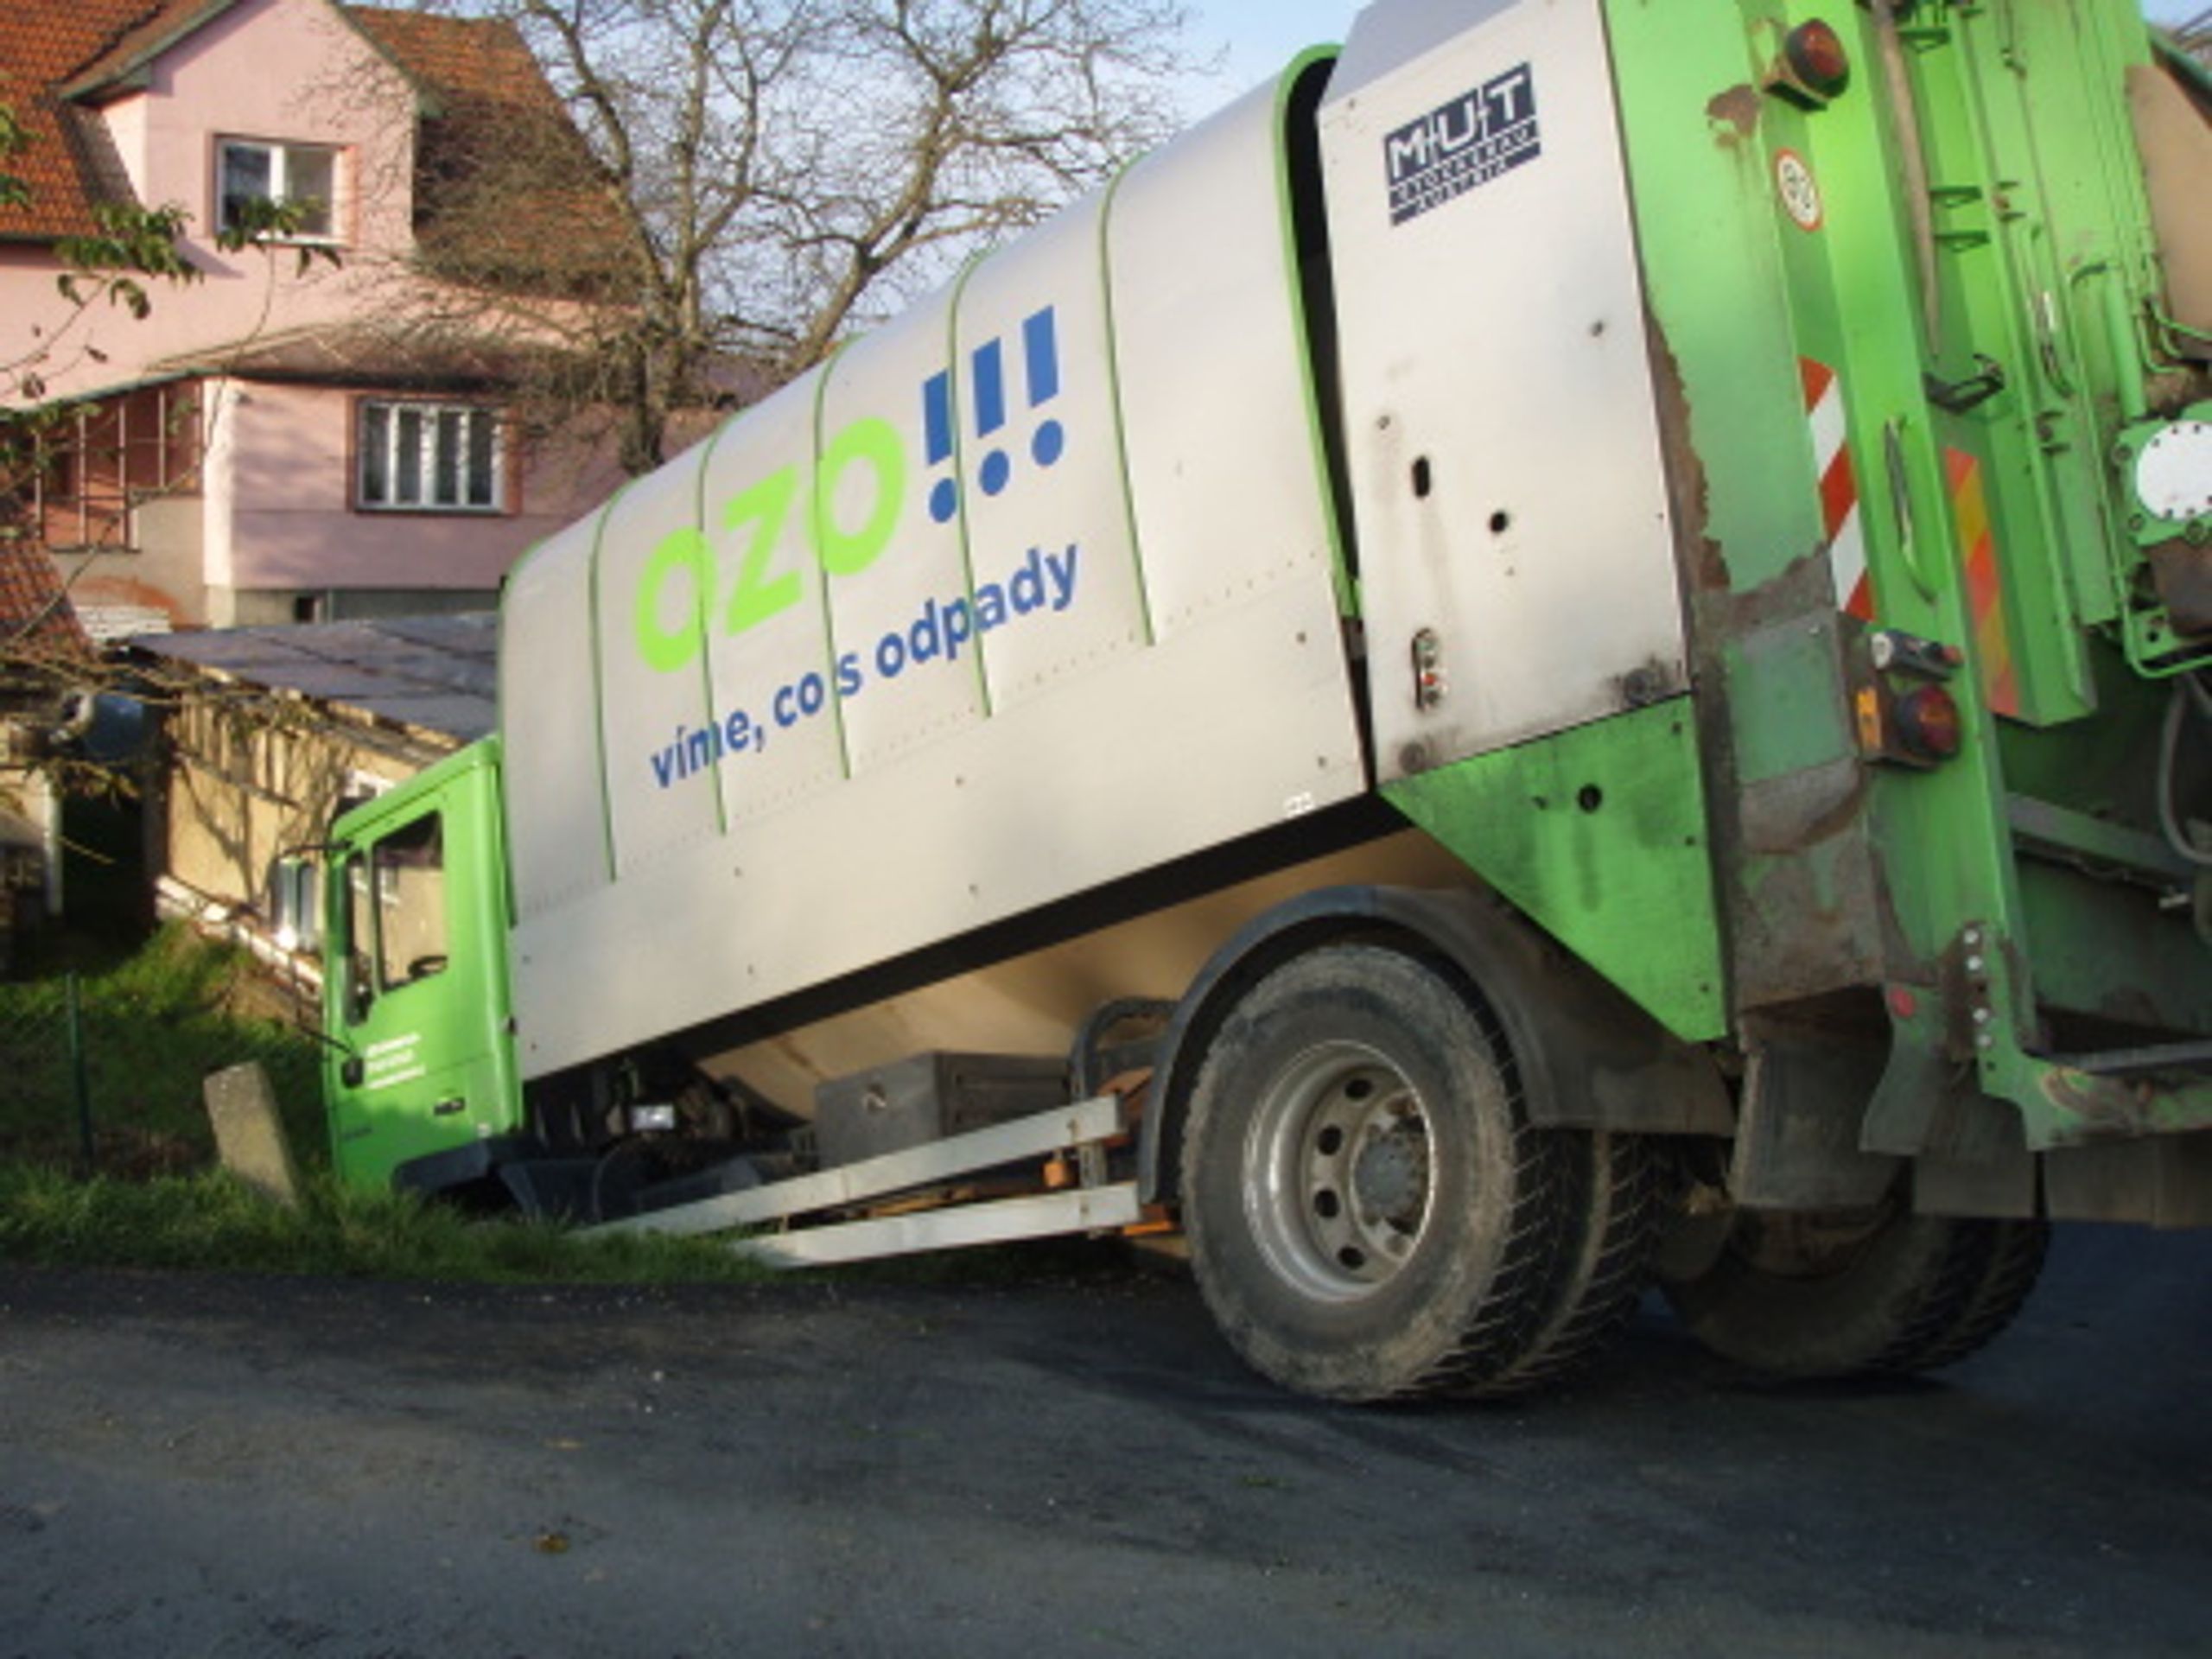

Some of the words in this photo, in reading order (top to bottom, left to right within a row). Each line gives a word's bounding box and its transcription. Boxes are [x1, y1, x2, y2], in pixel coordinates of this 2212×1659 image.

[652, 710, 765, 788] víme,
[772, 672, 824, 728] co
[836, 652, 862, 696] s
[875, 543, 1077, 677] odpady
